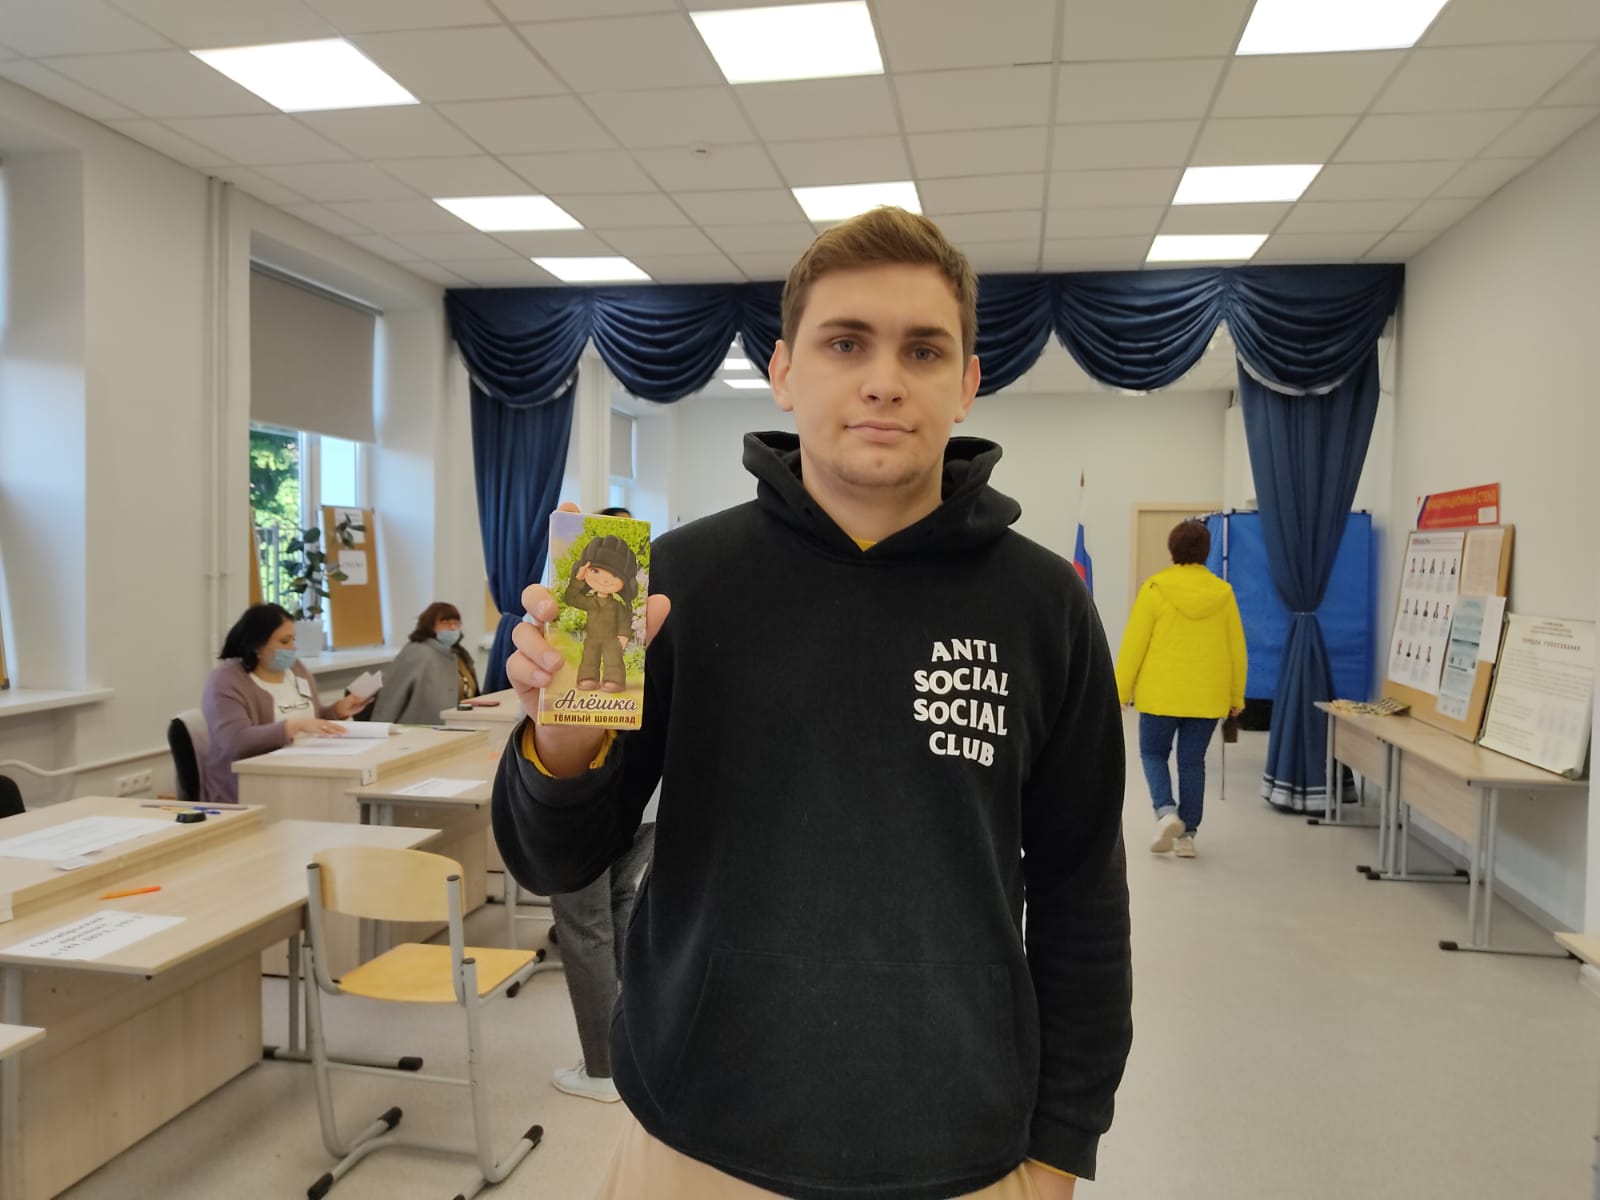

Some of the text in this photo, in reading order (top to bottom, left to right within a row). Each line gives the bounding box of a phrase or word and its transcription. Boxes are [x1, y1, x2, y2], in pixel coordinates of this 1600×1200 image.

[931, 638, 998, 663] ANTI
[913, 666, 1009, 697] SOCIAL
[554, 689, 638, 711] Алёшка
[913, 698, 1008, 736] SOCIAL
[928, 730, 995, 767] CLUB
